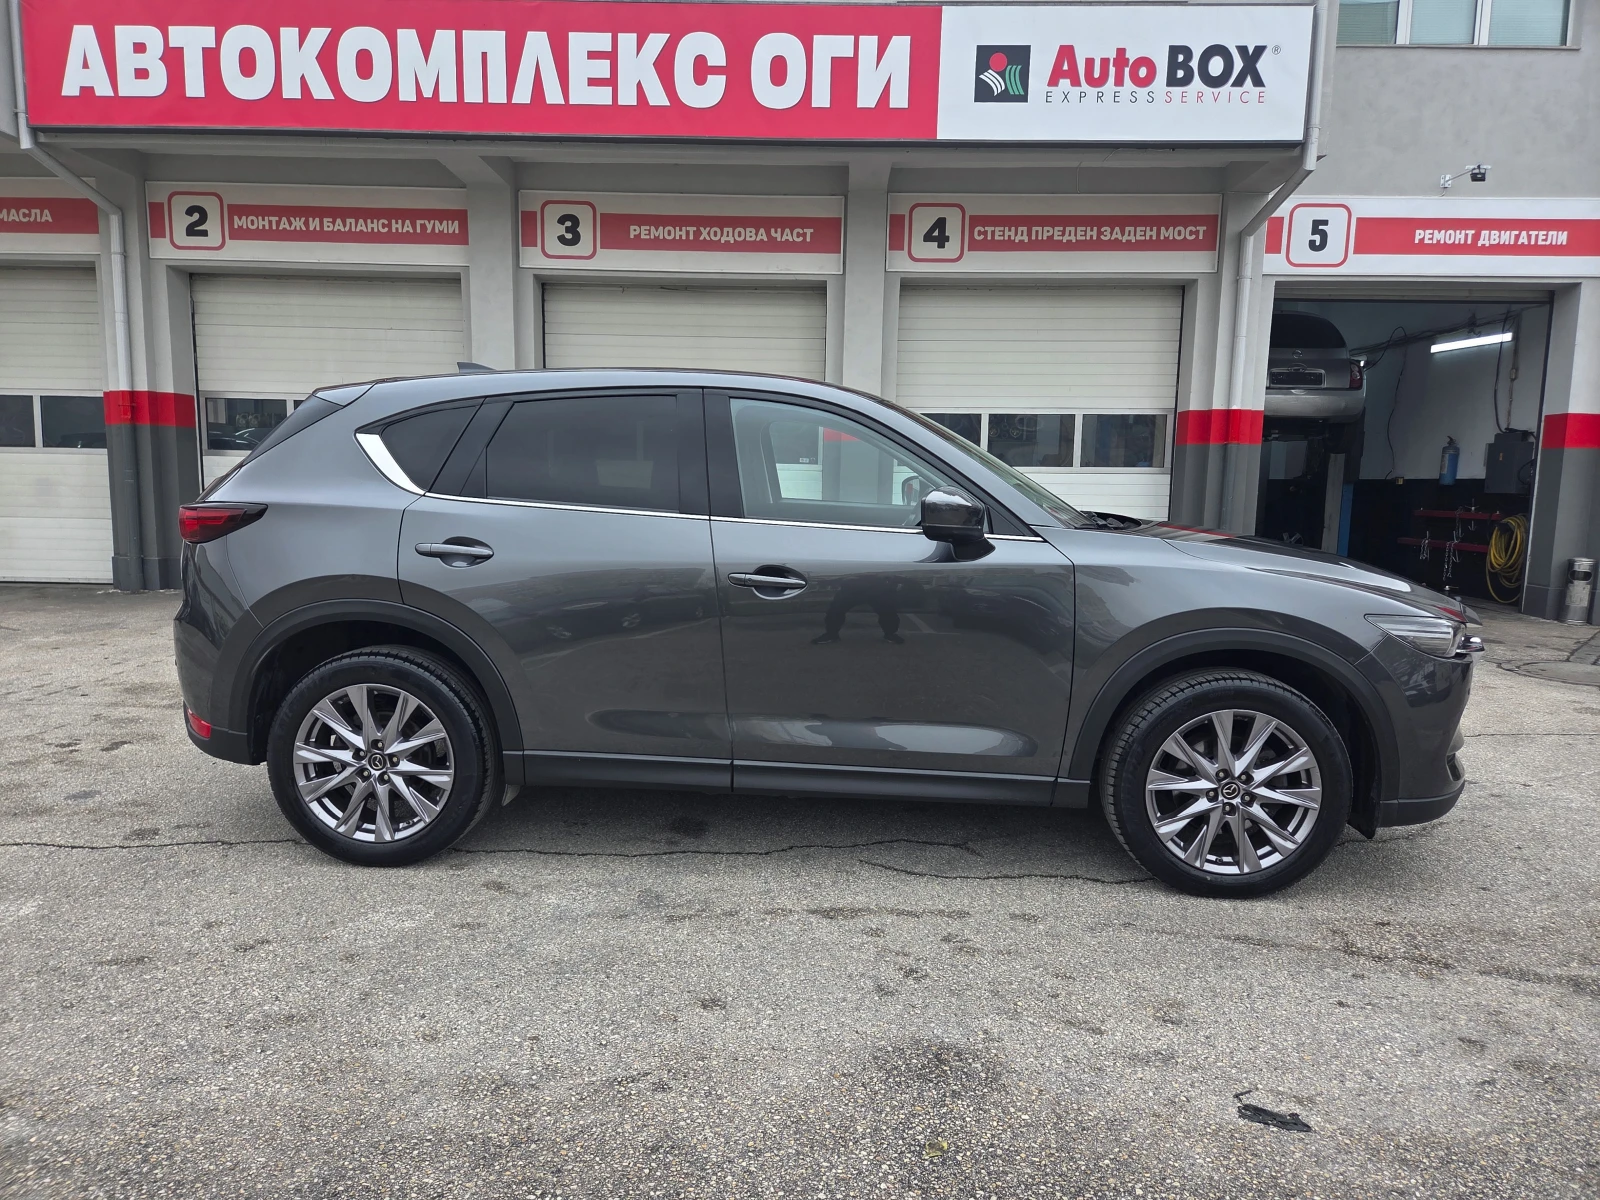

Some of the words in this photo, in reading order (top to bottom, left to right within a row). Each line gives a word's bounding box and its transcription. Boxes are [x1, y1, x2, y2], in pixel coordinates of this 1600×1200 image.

[61, 25, 727, 109] АВТОКОМПЛЕКС
[750, 33, 911, 109] ОГИ
[1047, 45, 1157, 88] Auto
[1166, 44, 1267, 88] BOX
[185, 205, 208, 237] 2
[233, 215, 307, 231] МОНТАЖ
[309, 217, 319, 231] И
[323, 217, 389, 233] БАЛАНС
[391, 219, 413, 233] НА
[416, 219, 459, 234] ГУМИ
[557, 214, 581, 246] 3
[629, 225, 697, 240] РЕМОНТ
[699, 226, 768, 244] ХОДОВА
[770, 228, 814, 242] ЧАСТ
[923, 217, 950, 249] 4
[973, 226, 1029, 243] СТЕНД
[1031, 226, 1097, 243] ПРЕДЕН
[1100, 226, 1157, 243] ЗАДЕН
[1160, 226, 1207, 241] МОСТ
[1308, 219, 1329, 252] 5
[1414, 229, 1476, 245] РЕМОНТ
[1477, 230, 1568, 247] ДВИГАТЕЛИ
